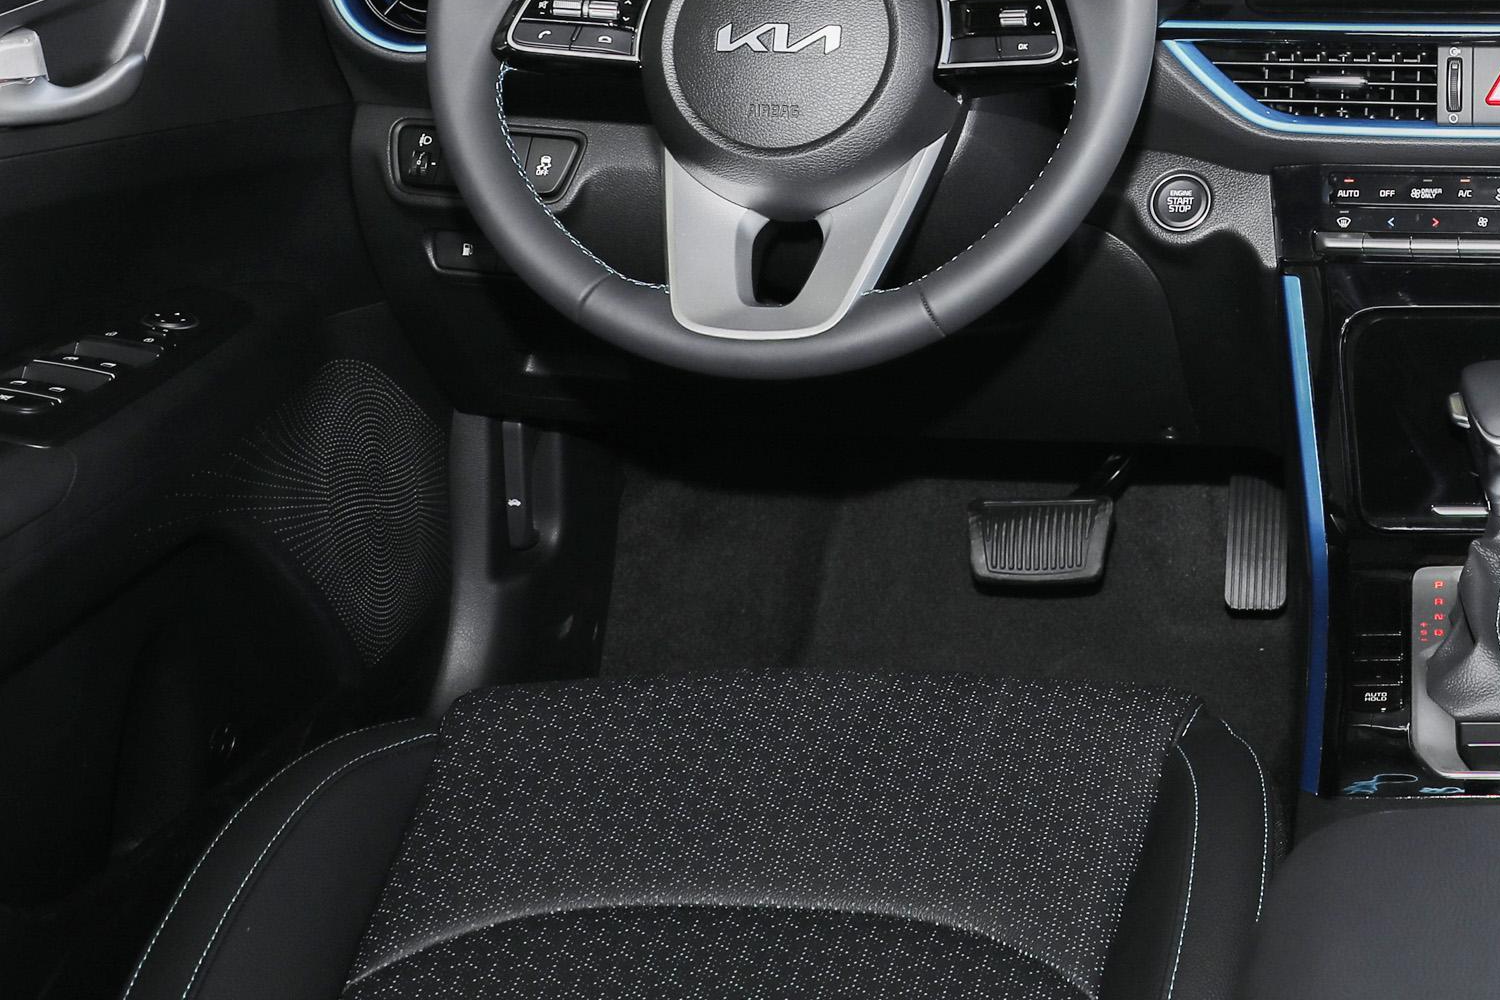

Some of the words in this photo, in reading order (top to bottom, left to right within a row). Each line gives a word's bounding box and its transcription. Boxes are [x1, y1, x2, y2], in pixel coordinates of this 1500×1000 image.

[716, 23, 842, 55] KIA
[748, 103, 800, 118] AIRBAG
[1337, 189, 1360, 198] AUTO
[1379, 189, 1396, 197] OFF
[1458, 189, 1472, 198] A/C
[1167, 197, 1194, 205] START
[1168, 205, 1191, 213] STOP
[1434, 580, 1444, 589] P
